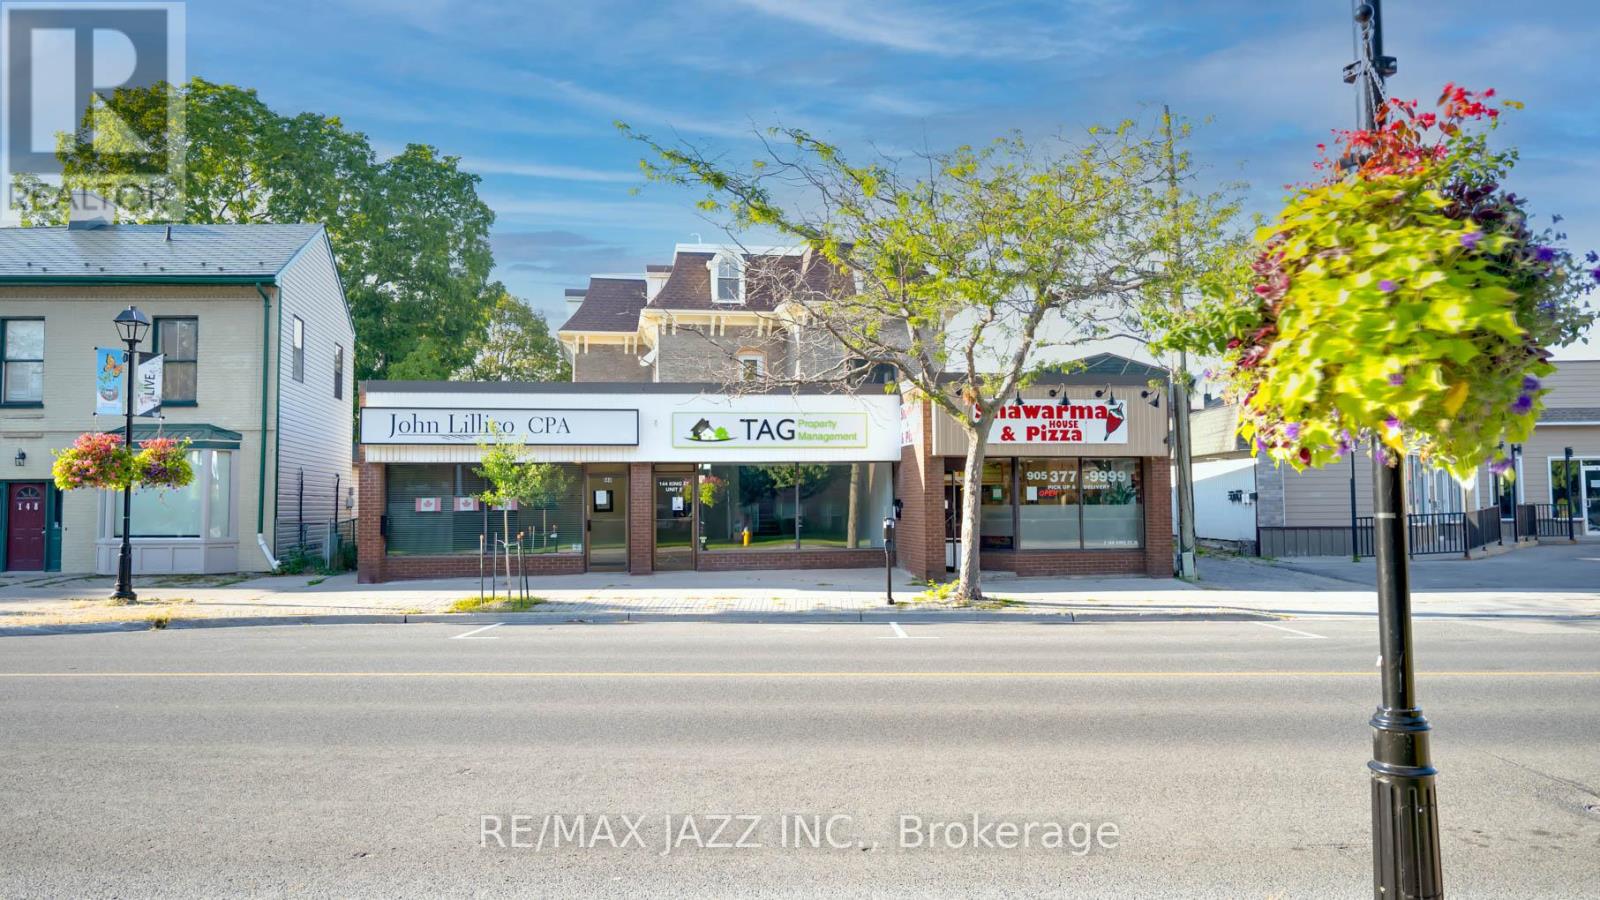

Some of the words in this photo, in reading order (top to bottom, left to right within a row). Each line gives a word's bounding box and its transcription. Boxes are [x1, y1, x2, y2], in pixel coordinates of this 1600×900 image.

[144, 374, 156, 396] LIVE
[390, 413, 439, 438] John
[527, 416, 571, 434] CPA
[739, 418, 796, 441] TAG
[798, 419, 838, 430] Property
[1049, 420, 1079, 429] HOUSE
[798, 432, 857, 443] Management
[1000, 426, 1016, 442] &
[1026, 424, 1083, 442] Pizza
[1026, 471, 1048, 480] 905
[1049, 470, 1077, 482] 377
[1085, 470, 1126, 482] -9999
[18, 502, 39, 511] 148
